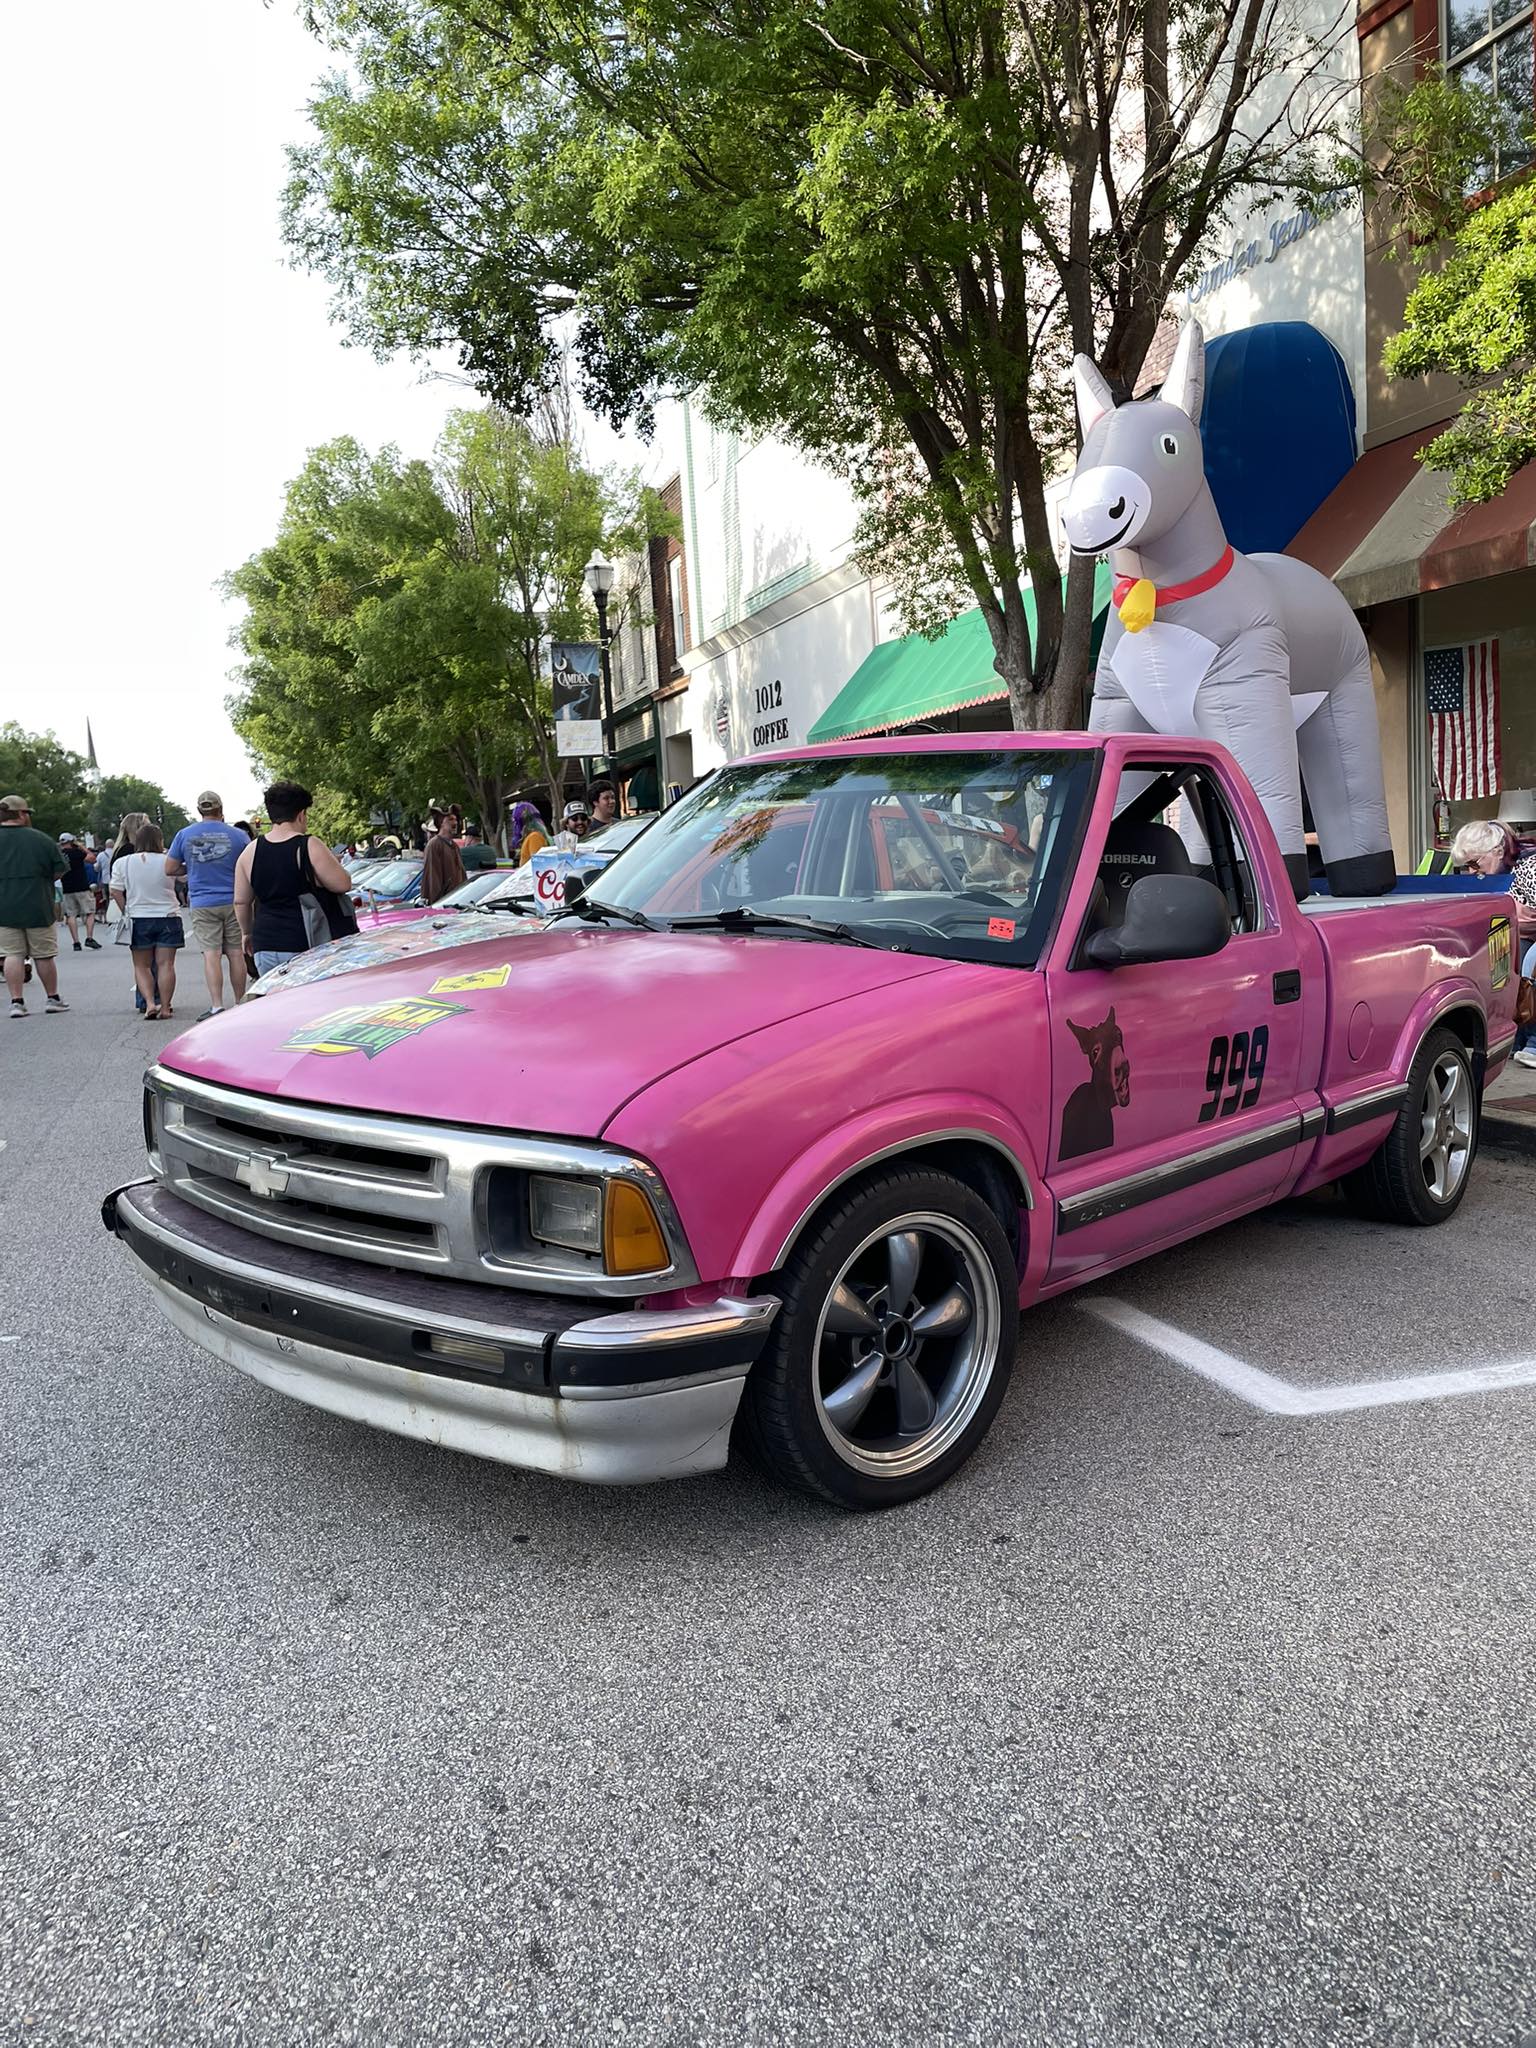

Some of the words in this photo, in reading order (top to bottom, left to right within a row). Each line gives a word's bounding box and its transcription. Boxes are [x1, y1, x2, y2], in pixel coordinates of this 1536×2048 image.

[553, 671, 592, 689] CAMDEN
[755, 680, 782, 713] 1012
[753, 718, 789, 747] COFFEE
[1101, 854, 1156, 865] ORBEAU
[1198, 1024, 1269, 1123] 999
